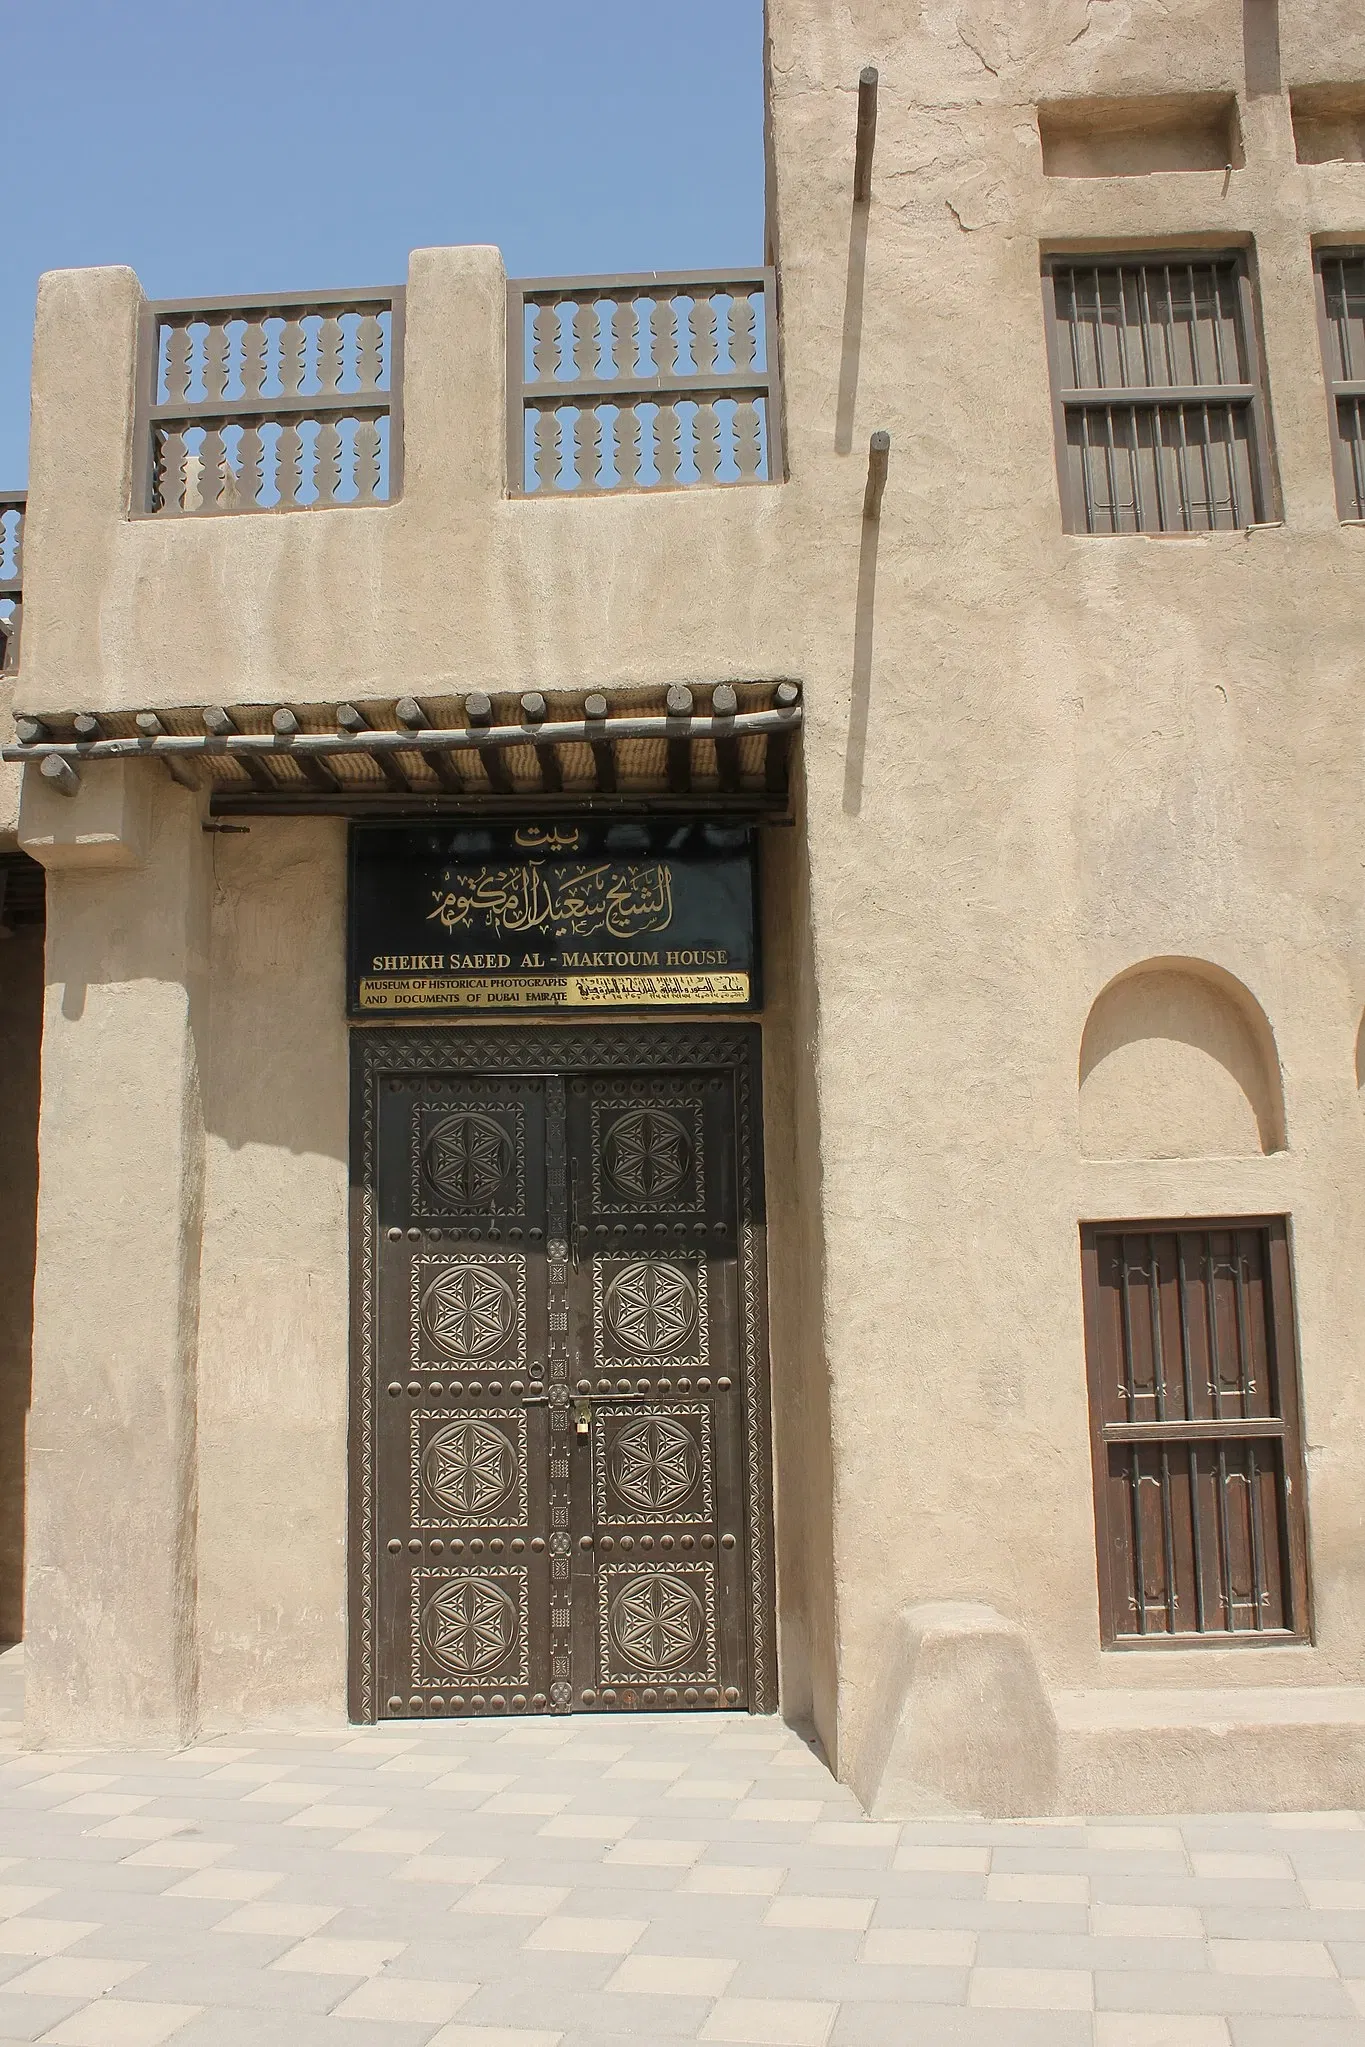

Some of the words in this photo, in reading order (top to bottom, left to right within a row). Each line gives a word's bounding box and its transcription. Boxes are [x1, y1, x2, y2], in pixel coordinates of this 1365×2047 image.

[515, 827, 579, 851] بيت
[426, 868, 519, 930] مكتوم
[522, 863, 612, 937] سعيد
[606, 863, 673, 939] الشيخ
[372, 955, 444, 971] SHEIKH
[450, 954, 511, 970] SAEED
[520, 953, 545, 969] AL
[562, 951, 659, 967] MAKTOUM
[666, 950, 728, 965] HOUSE
[364, 980, 410, 990] MUSEUM
[412, 980, 427, 989] OF
[429, 979, 488, 989] HISTORICAL
[490, 978, 568, 988] PHOTOGRAPHS
[365, 995, 388, 1005] AND
[394, 994, 460, 1004] DOCUMENTS
[466, 994, 482, 1003] OF
[487, 993, 520, 1003] DUBAI
[526, 991, 568, 1002] EMIRATE
